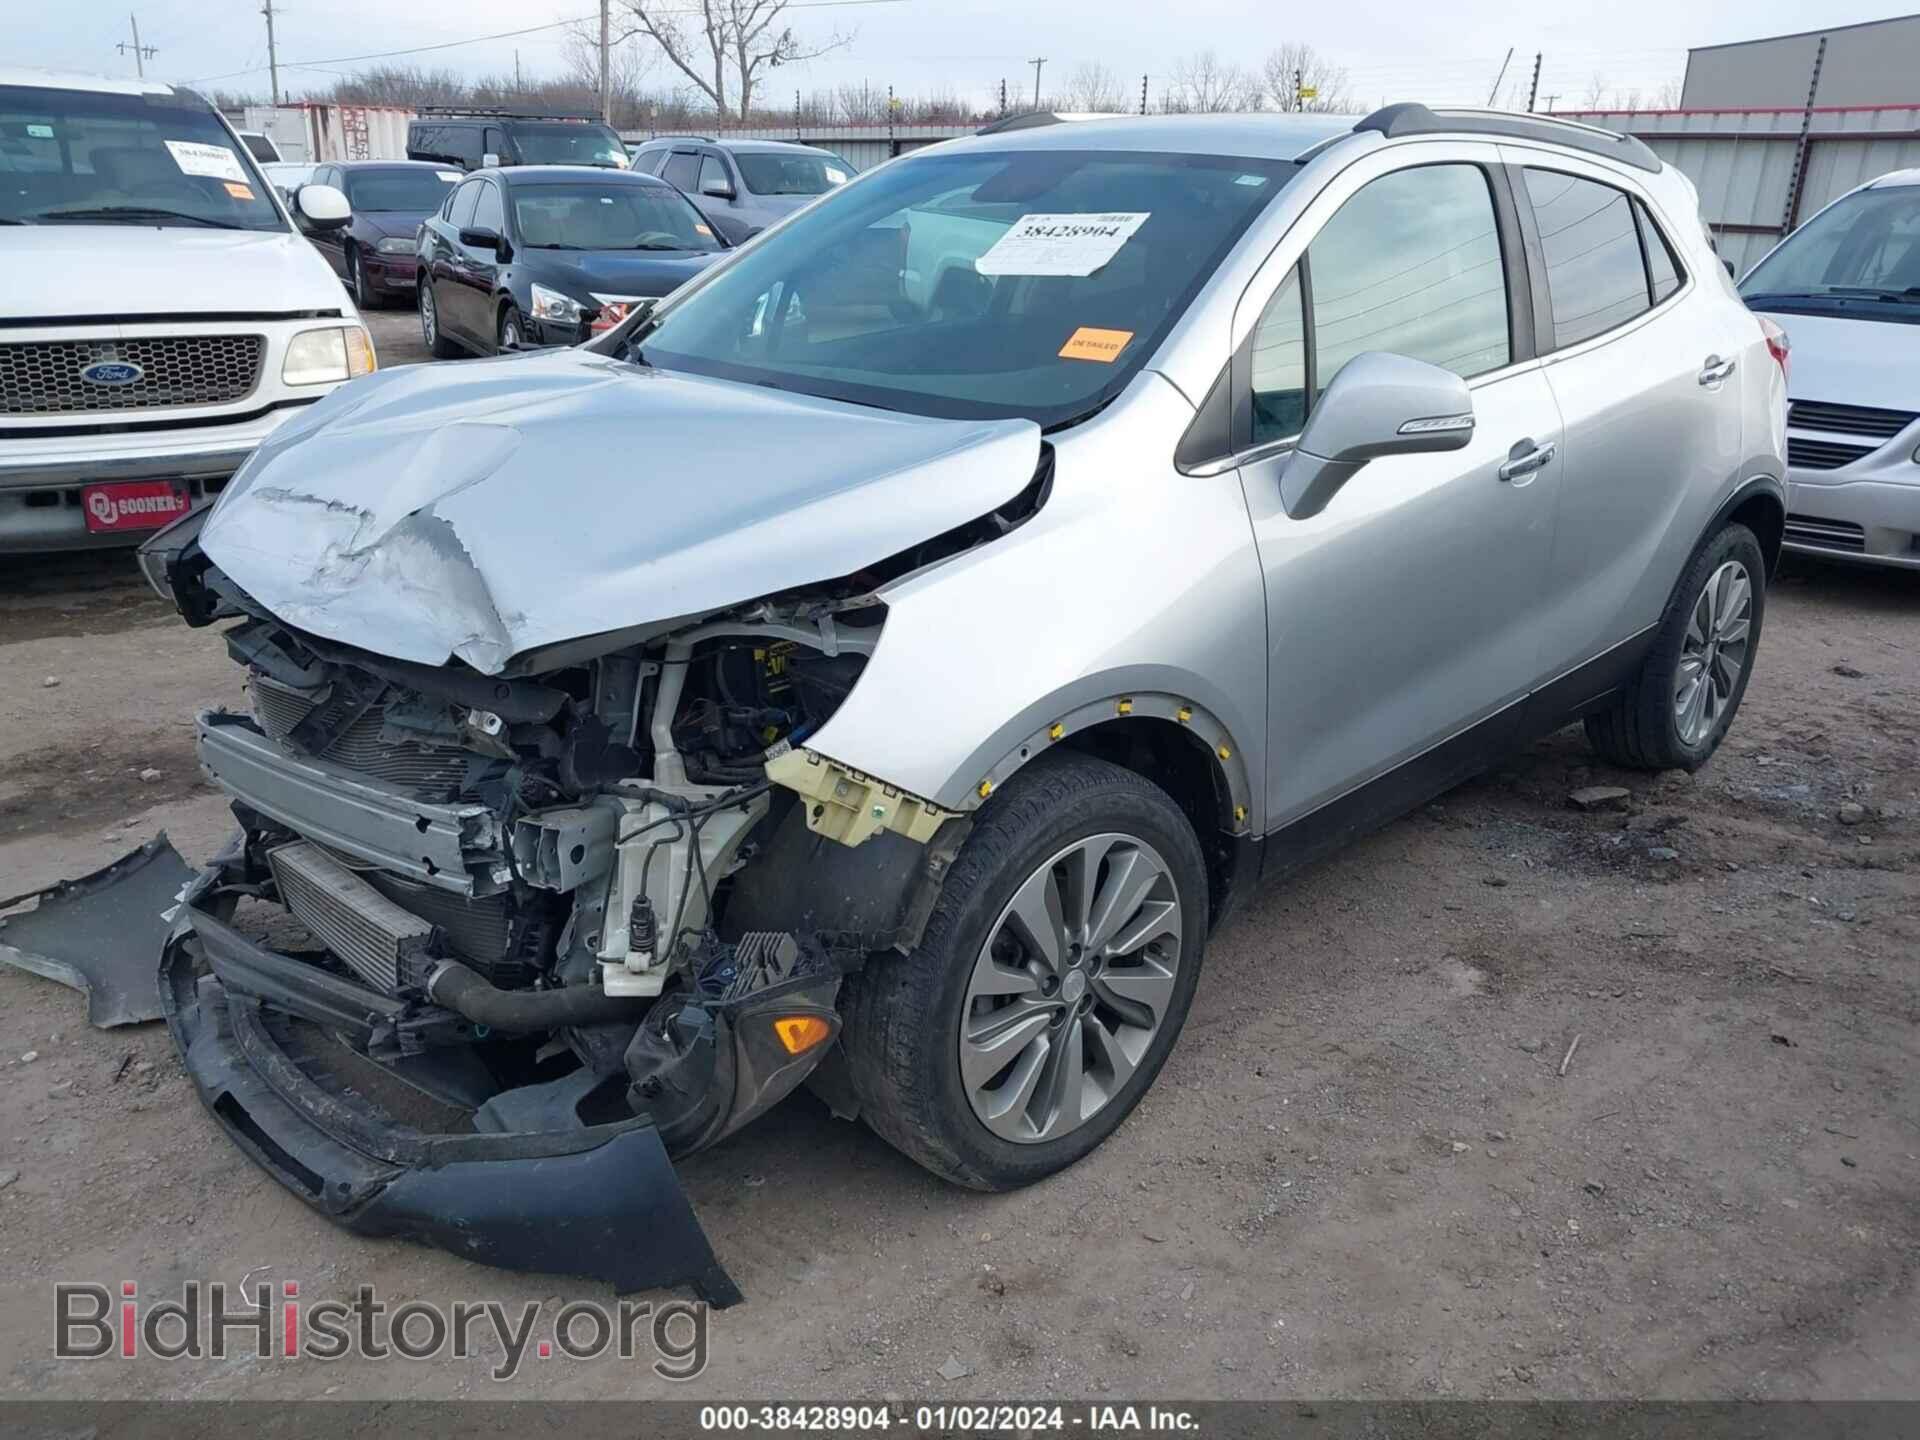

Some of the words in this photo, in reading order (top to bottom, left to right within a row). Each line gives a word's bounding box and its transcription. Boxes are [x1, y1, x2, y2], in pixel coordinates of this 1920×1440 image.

[1016, 224, 1121, 238] 38428904
[1071, 340, 1120, 351] DETAILED
[96, 366, 130, 380] Ford
